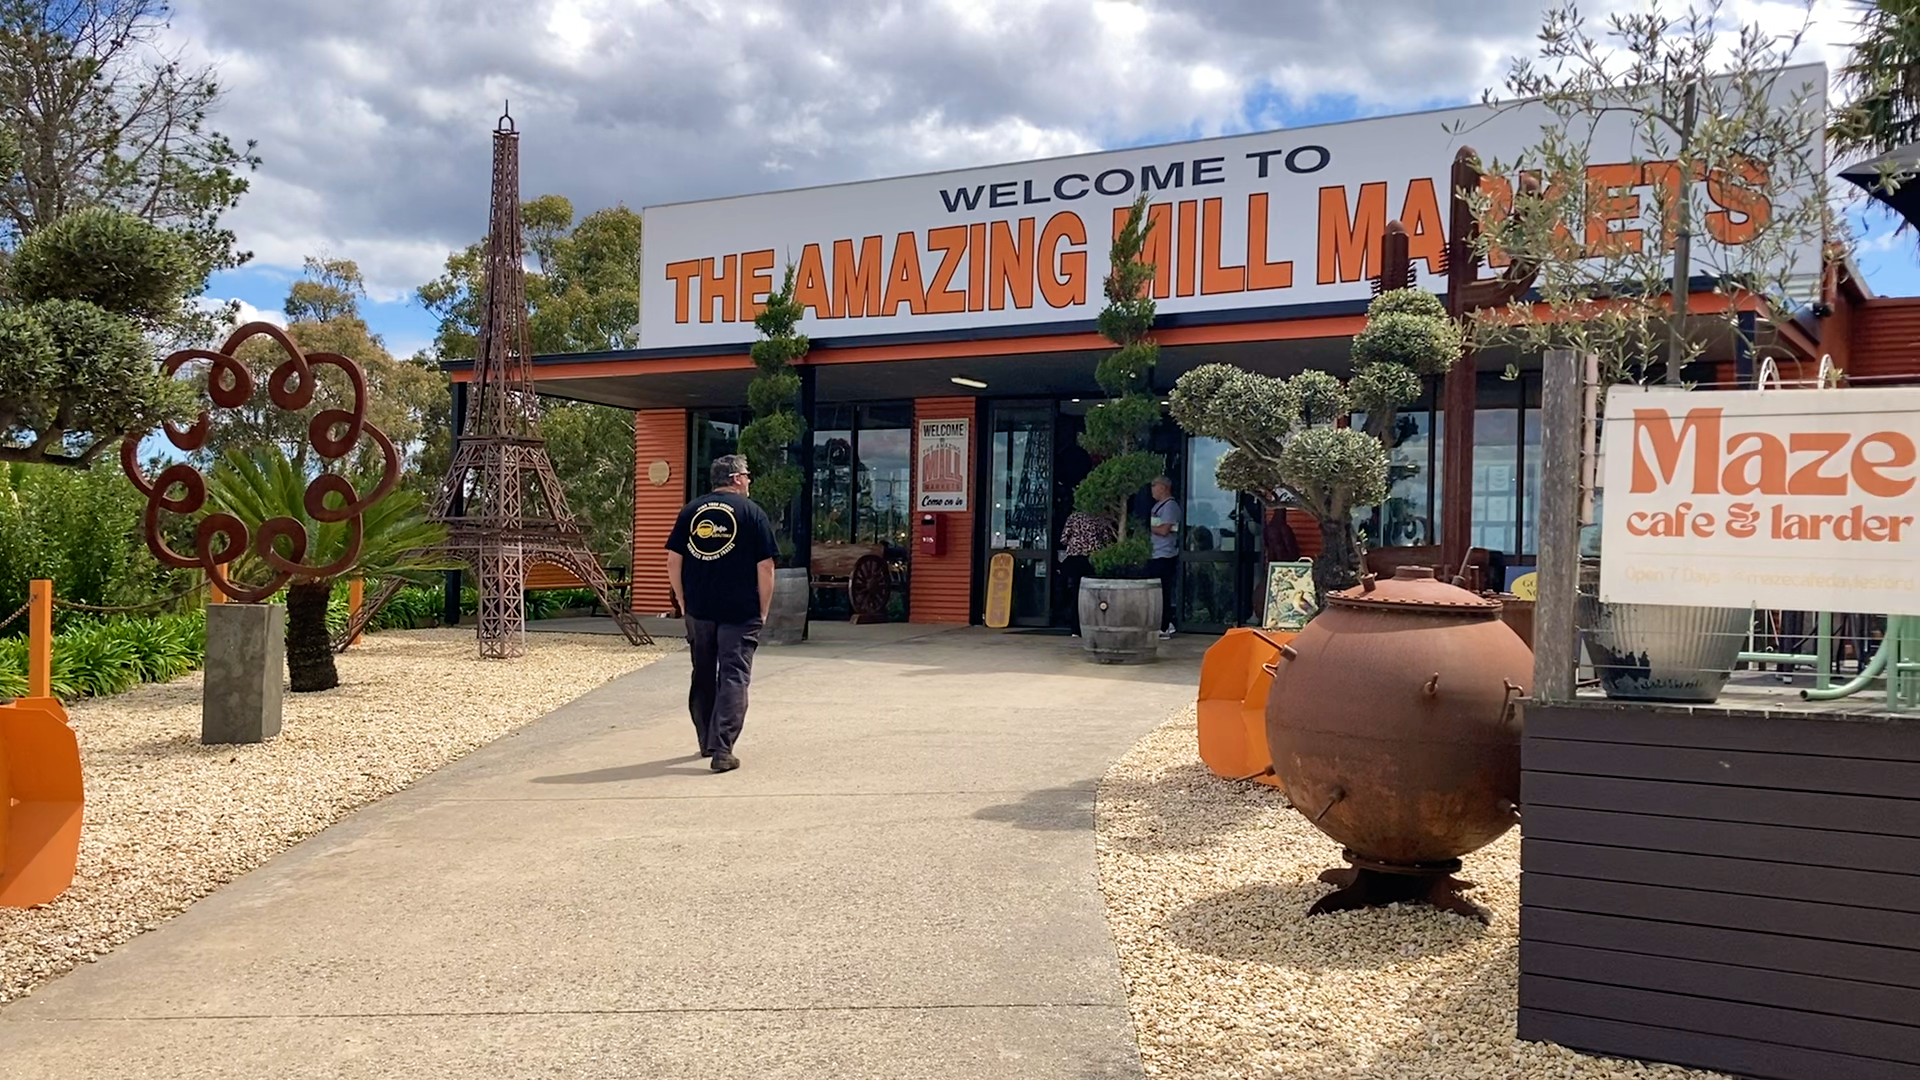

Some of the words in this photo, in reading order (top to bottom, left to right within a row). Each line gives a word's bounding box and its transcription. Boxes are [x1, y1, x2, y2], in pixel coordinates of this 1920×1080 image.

[939, 157, 1225, 213] WELCOME
[1246, 145, 1331, 179] TO
[666, 249, 776, 324] THE
[795, 210, 1088, 320] AMAZING
[1112, 192, 1294, 301] MILL
[923, 424, 964, 437] WELCOME
[1629, 407, 1917, 498] Maze
[921, 495, 944, 507] Come
[944, 498, 954, 506] on
[955, 497, 963, 506] in
[1626, 502, 1716, 538] cafe
[1725, 502, 1761, 538] &
[1770, 504, 1915, 543] larder
[1624, 565, 1664, 585] Open
[1667, 566, 1679, 581] 7
[1682, 567, 1721, 586] Days
